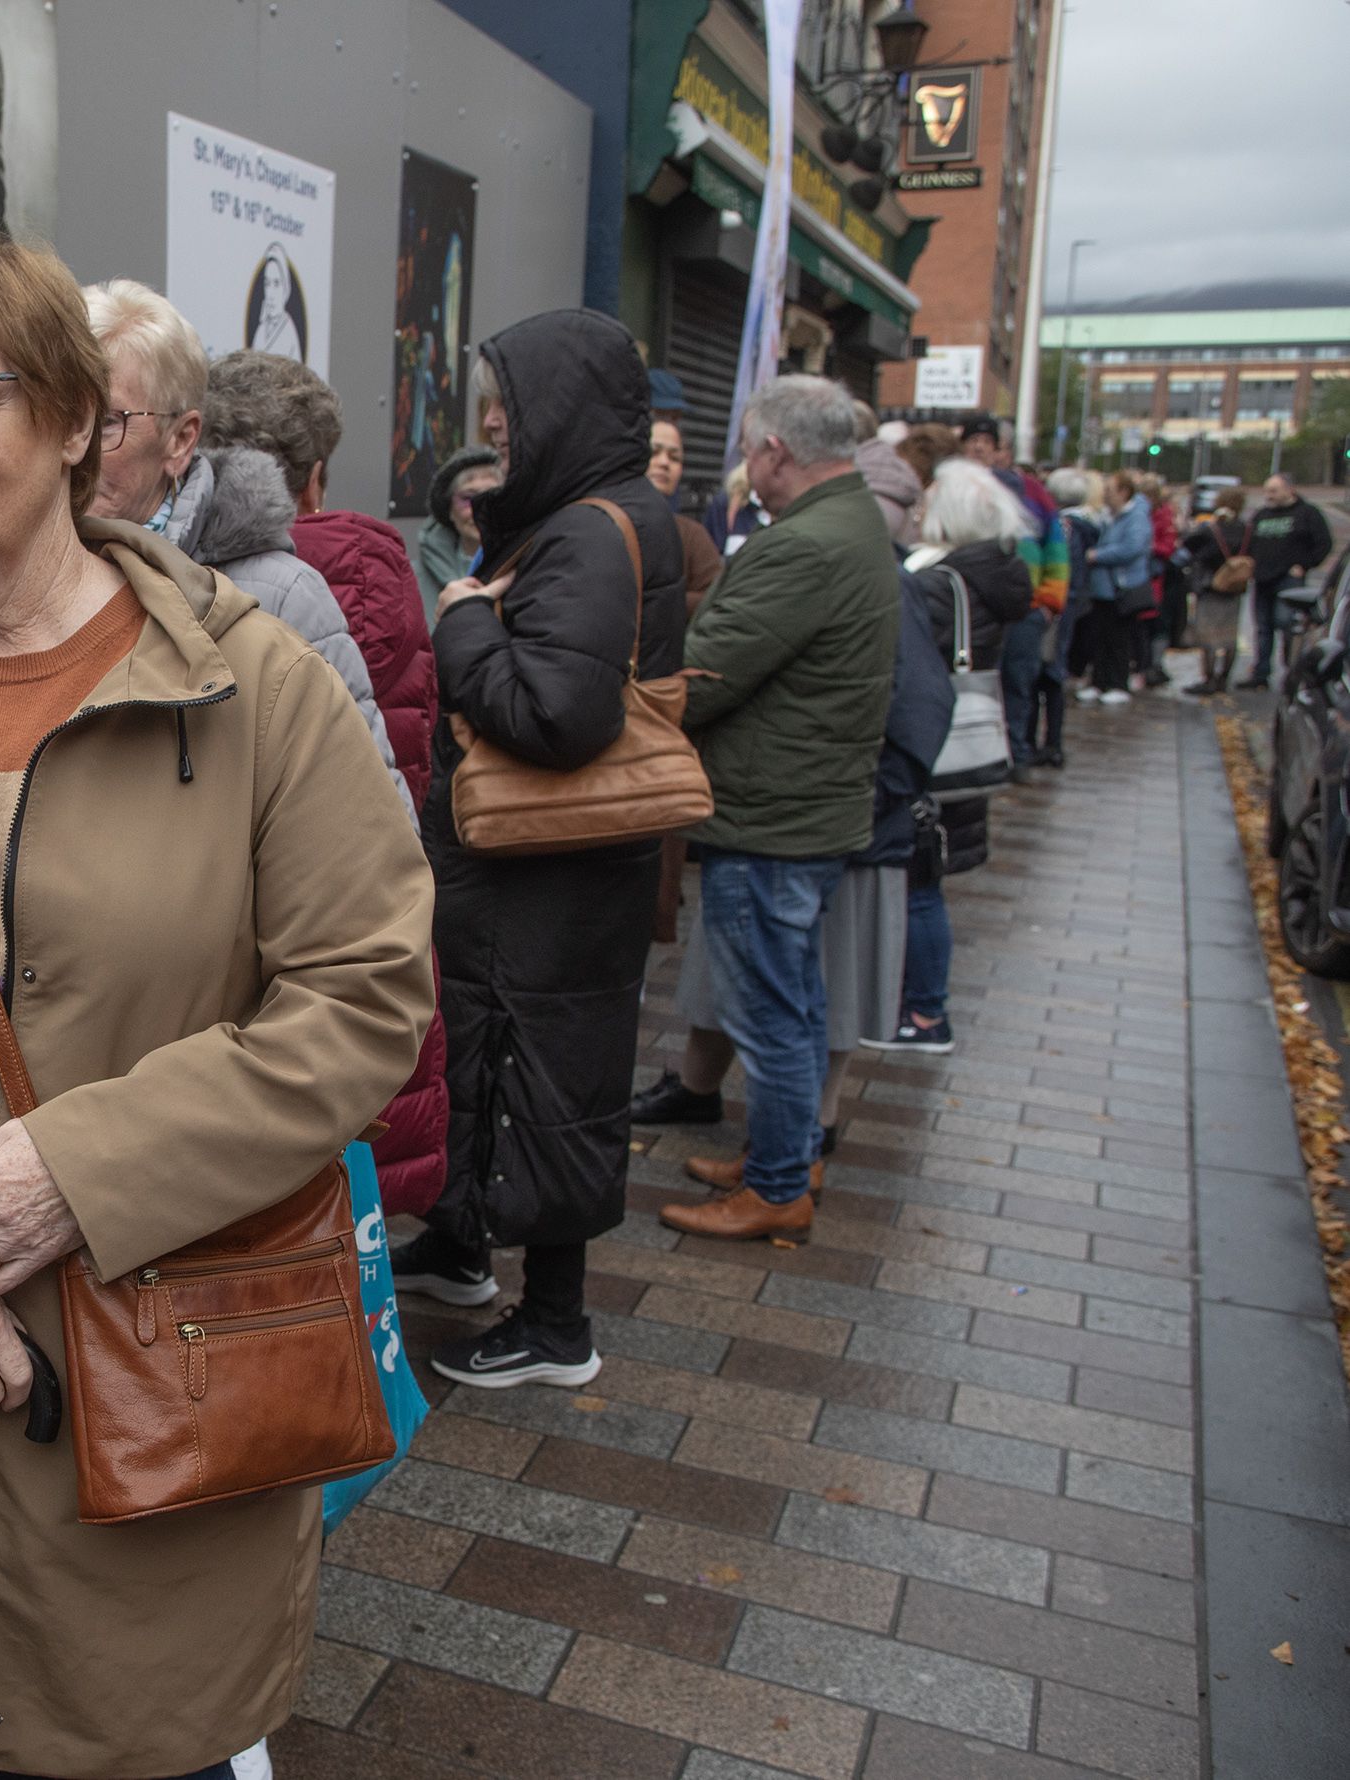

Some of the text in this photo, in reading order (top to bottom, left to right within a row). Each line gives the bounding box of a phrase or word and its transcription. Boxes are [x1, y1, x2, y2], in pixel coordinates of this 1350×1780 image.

[193, 136, 211, 164] St.
[256, 156, 293, 191] Chapel
[293, 170, 318, 201] Lane
[899, 171, 978, 190] GUINNESS
[211, 190, 230, 215] 15th
[233, 196, 242, 219] &
[263, 206, 306, 237] October
